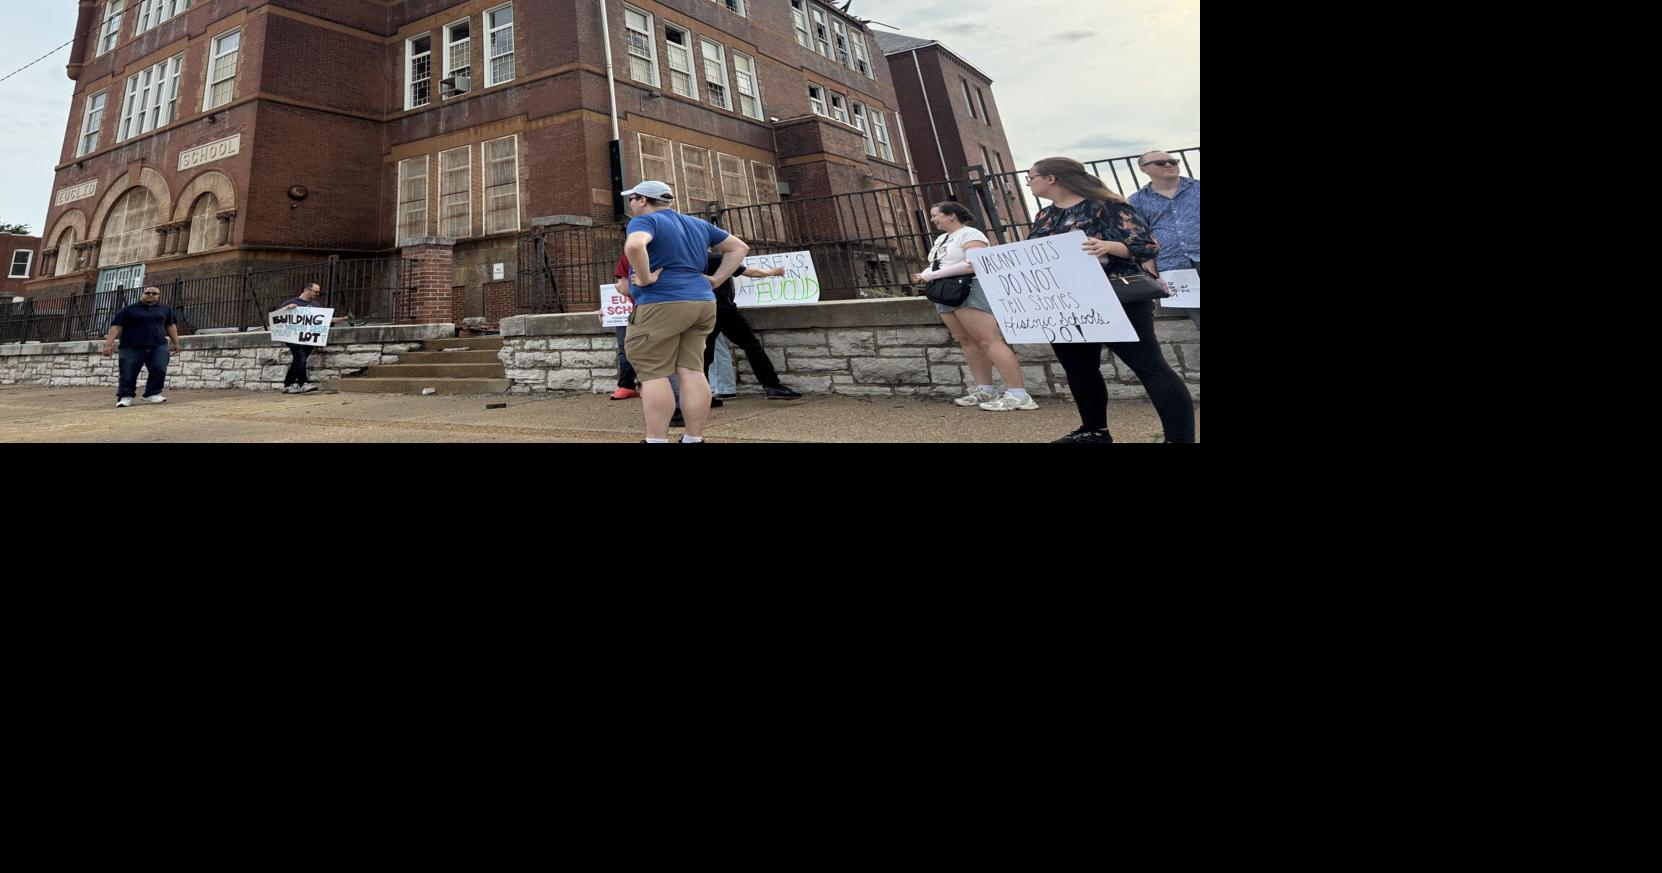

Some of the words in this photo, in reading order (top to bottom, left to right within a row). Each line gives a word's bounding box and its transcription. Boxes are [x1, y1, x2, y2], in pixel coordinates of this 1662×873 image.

[182, 138, 236, 167] SCHOOL
[57, 182, 95, 204] EUCLID
[745, 253, 809, 272] ERE'S,
[977, 249, 1022, 275] VACANT
[1023, 240, 1060, 266] LOTS
[738, 284, 755, 296] AT
[756, 277, 819, 304] EUCLID
[998, 273, 1022, 296] DO
[1021, 267, 1060, 293] NOT
[607, 305, 634, 316] SCH
[1028, 291, 1080, 312] Stories
[272, 314, 325, 326] BUILDING
[1004, 316, 1057, 337] Historic
[1043, 325, 1087, 343] DO!
